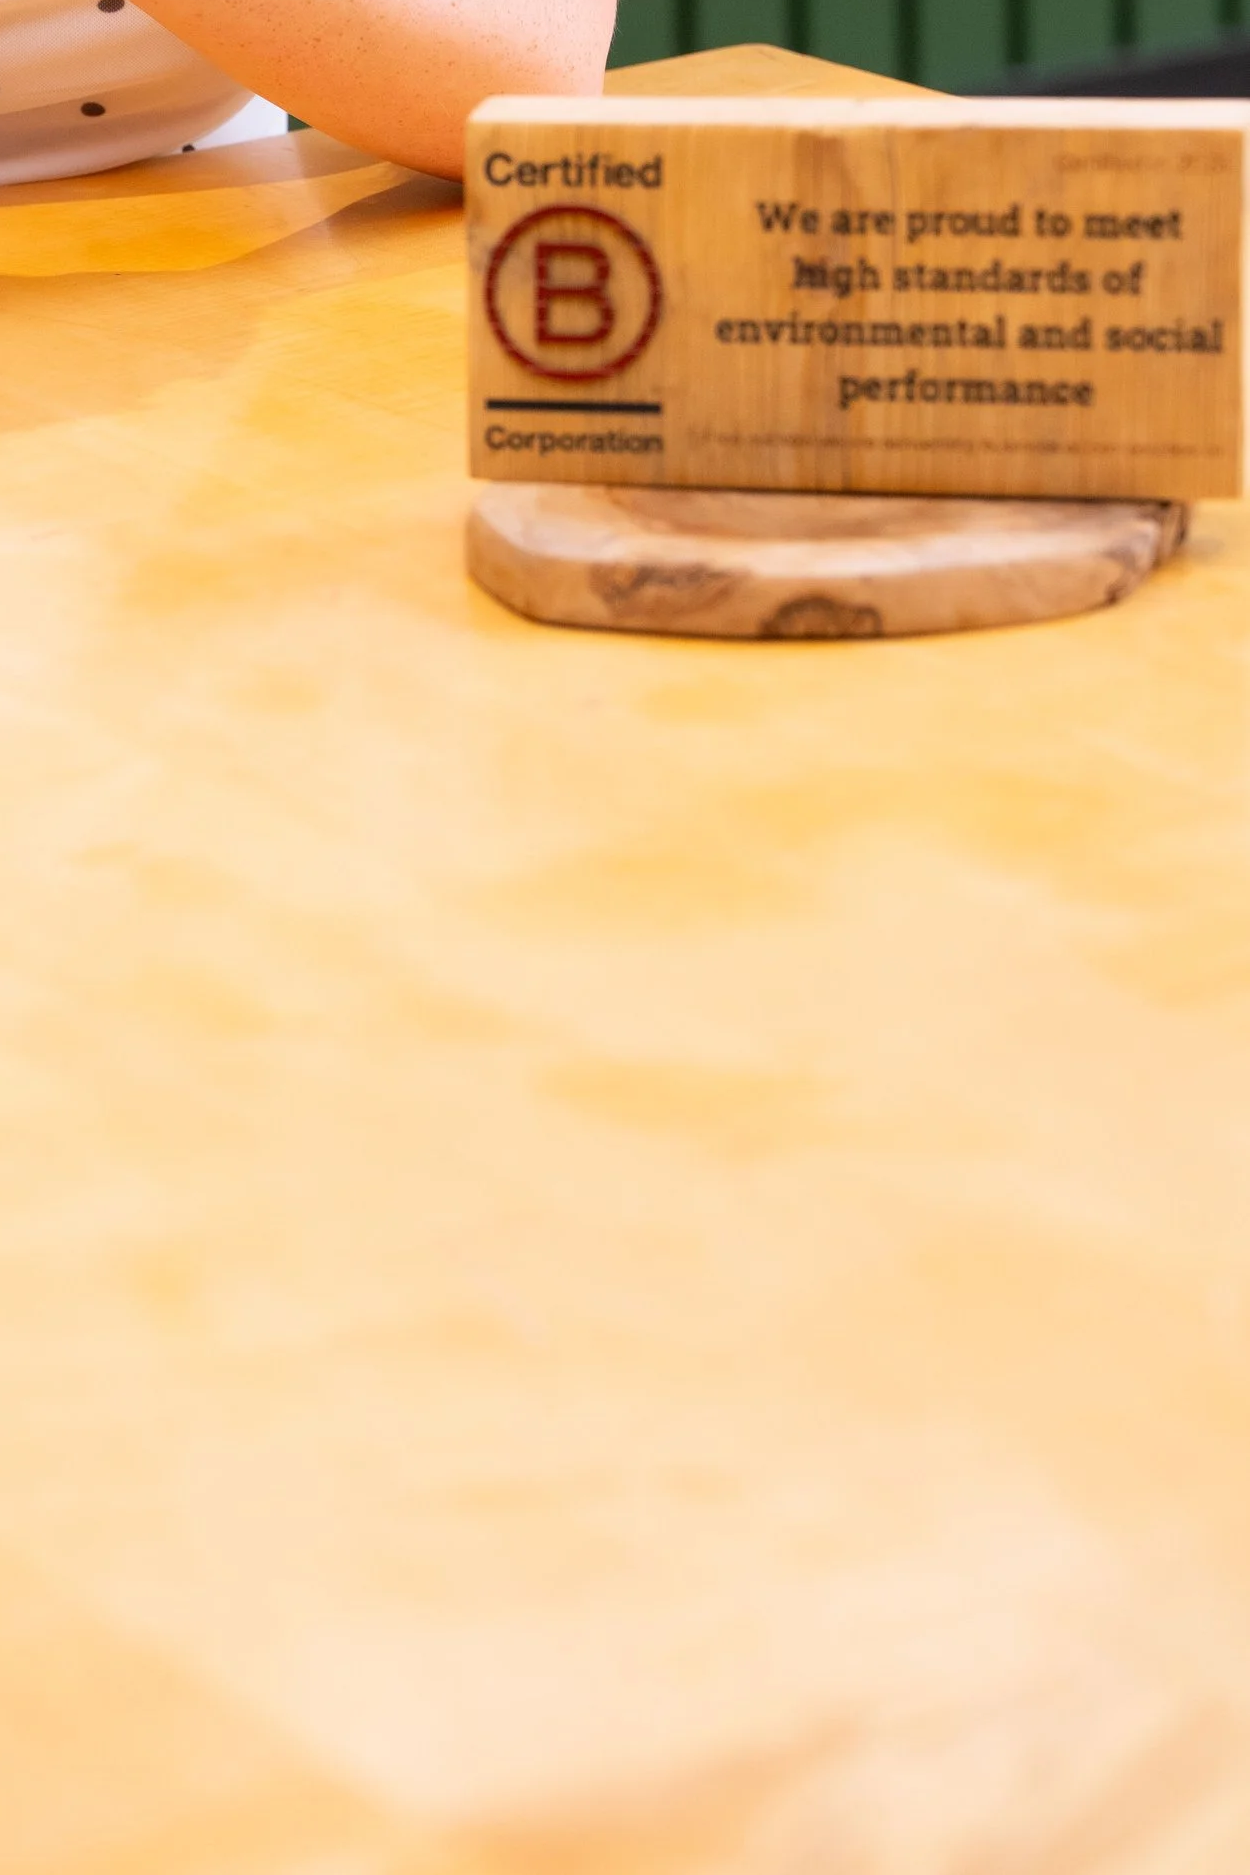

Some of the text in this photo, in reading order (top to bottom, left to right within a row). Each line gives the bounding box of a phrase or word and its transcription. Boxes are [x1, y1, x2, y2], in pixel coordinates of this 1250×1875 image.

[485, 152, 663, 189] Certified
[755, 201, 1182, 243] We are proud to meet
[534, 242, 617, 347] B
[793, 256, 1145, 298] high standards of
[716, 312, 1224, 354] environmental and social
[839, 369, 1094, 409] performance
[485, 426, 663, 455] Corporation
